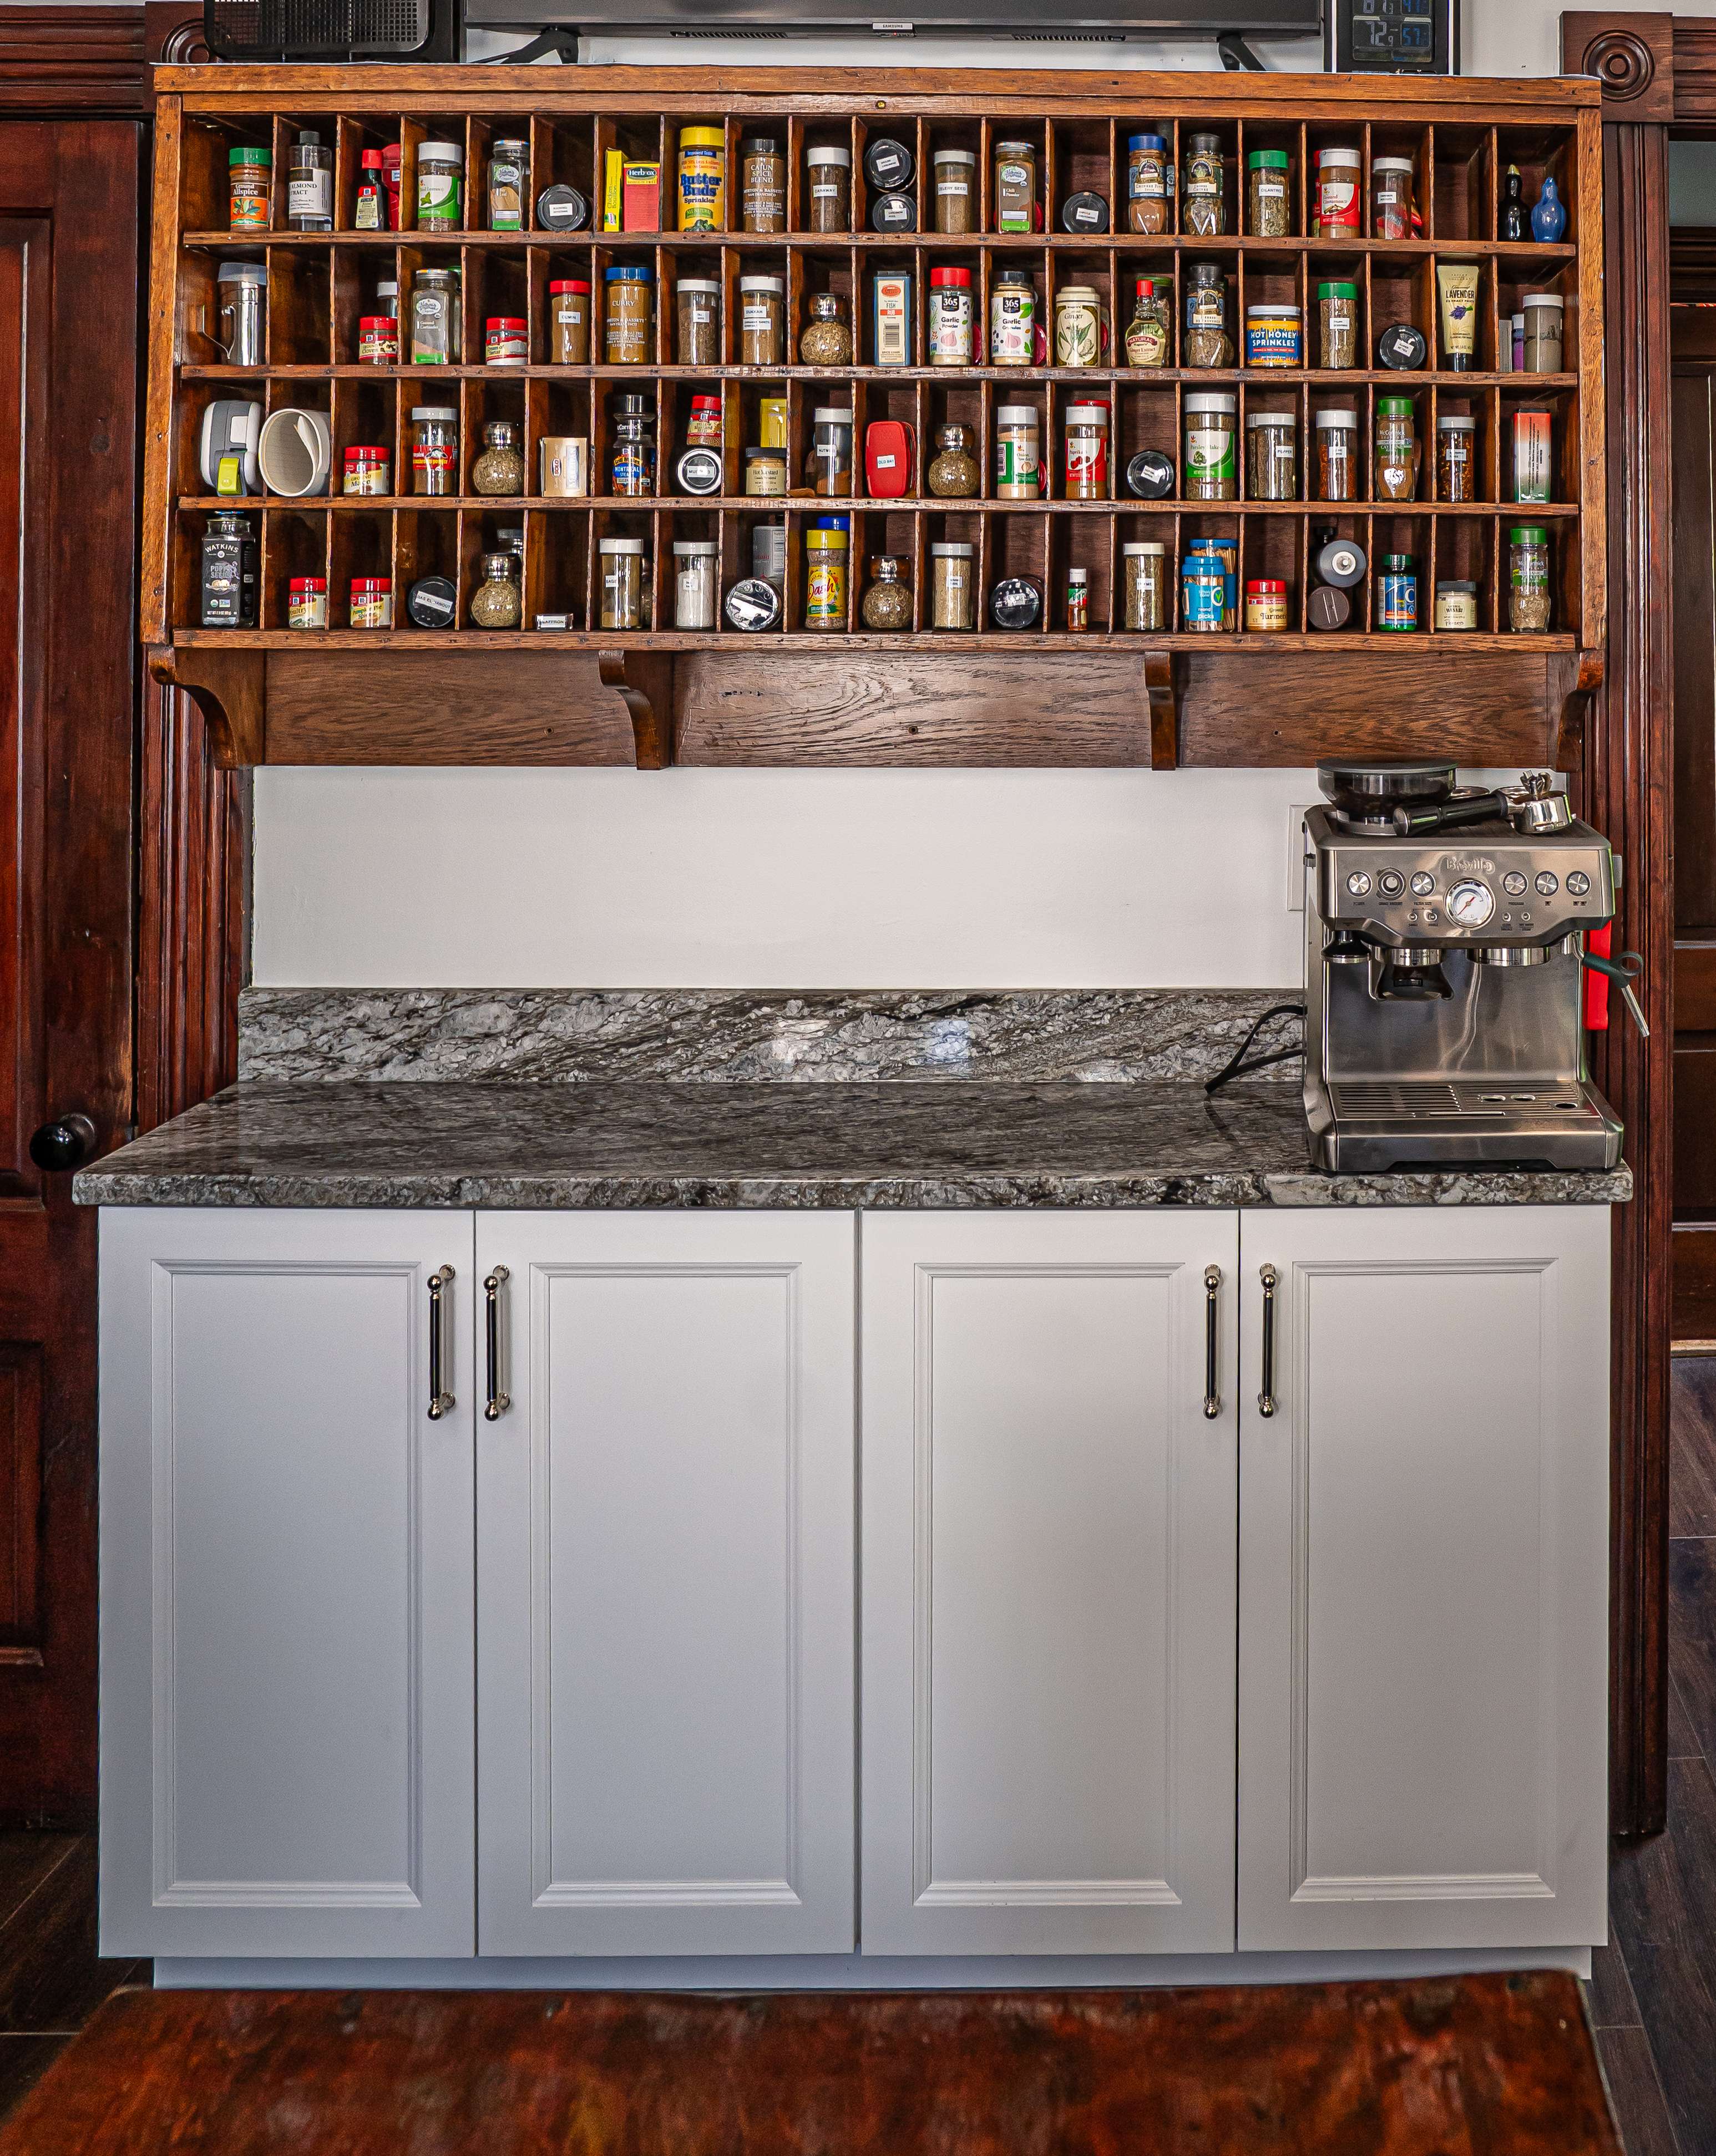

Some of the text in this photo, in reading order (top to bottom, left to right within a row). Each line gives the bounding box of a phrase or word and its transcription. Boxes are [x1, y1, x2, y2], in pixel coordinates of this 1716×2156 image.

[678, 173, 722, 186] Butter
[682, 184, 717, 197] Buds
[1446, 290, 1475, 299] LAVENDER
[943, 297, 958, 306] 365
[205, 544, 239, 553] WATKINS
[808, 577, 835, 599] Dash
